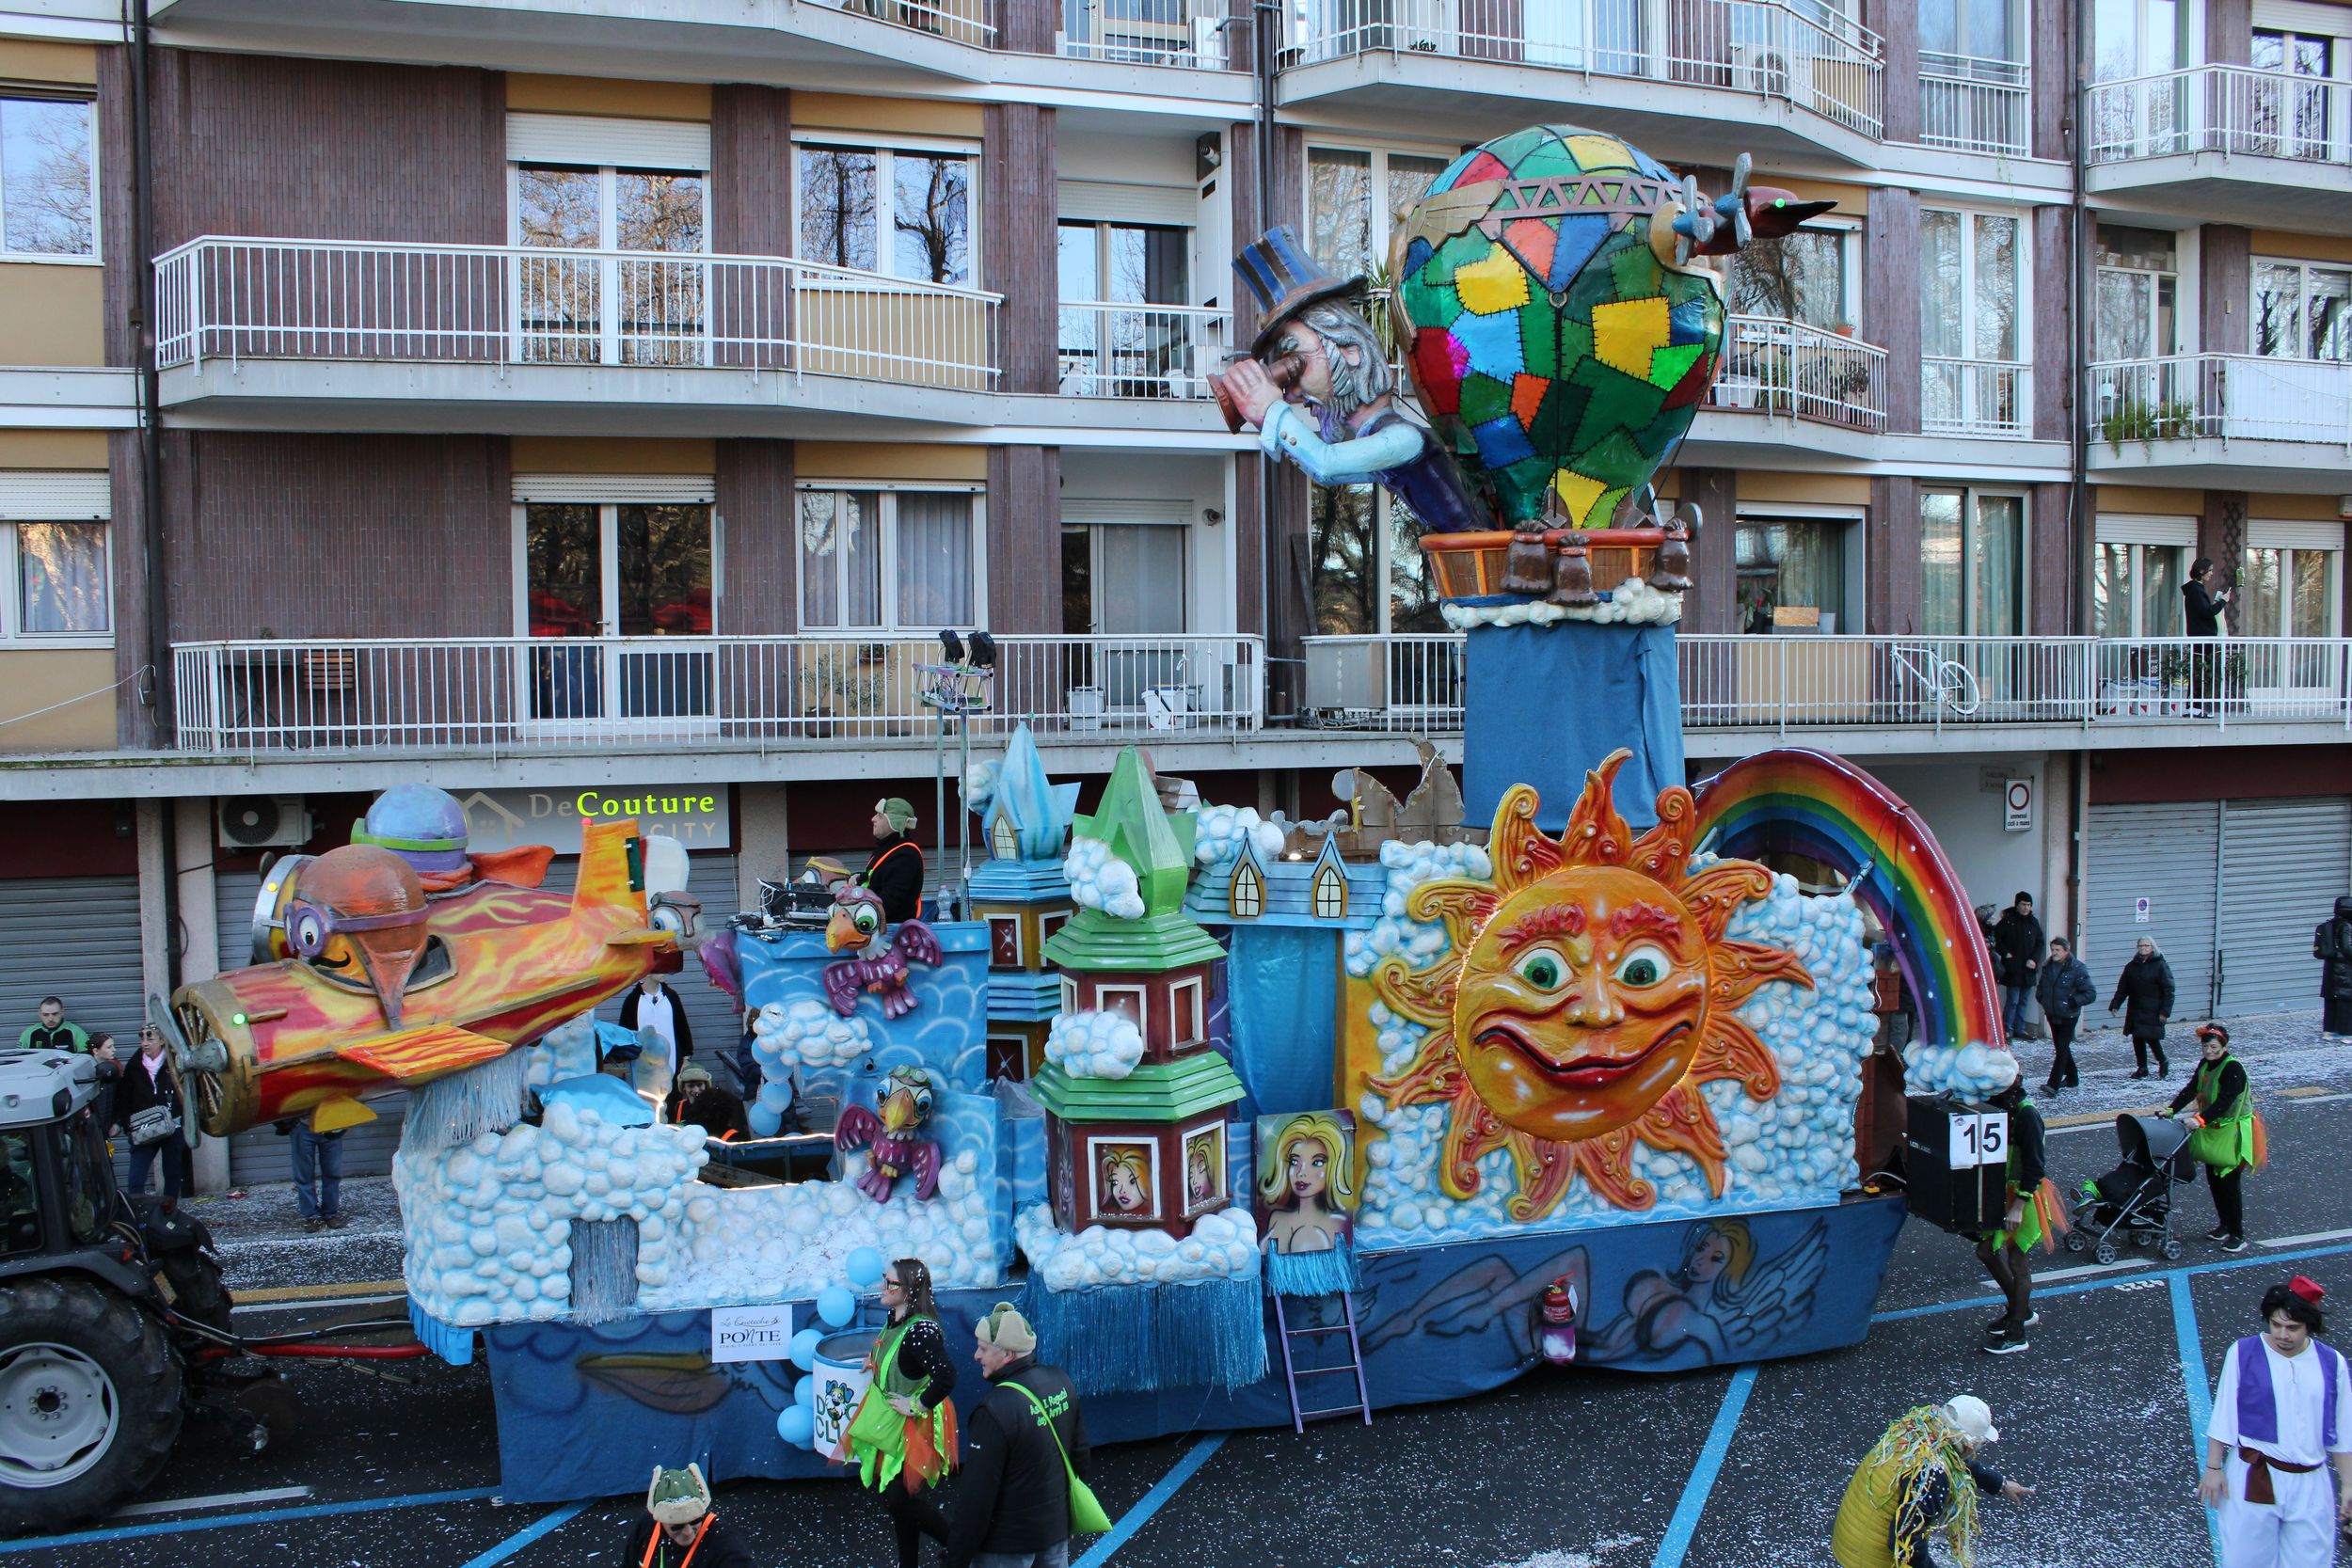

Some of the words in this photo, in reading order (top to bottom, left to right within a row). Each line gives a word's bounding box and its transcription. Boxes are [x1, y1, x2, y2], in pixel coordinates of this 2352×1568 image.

[529, 791, 715, 818] DeCouture
[649, 822, 716, 839] CITY
[1963, 1122, 2001, 1154] 15
